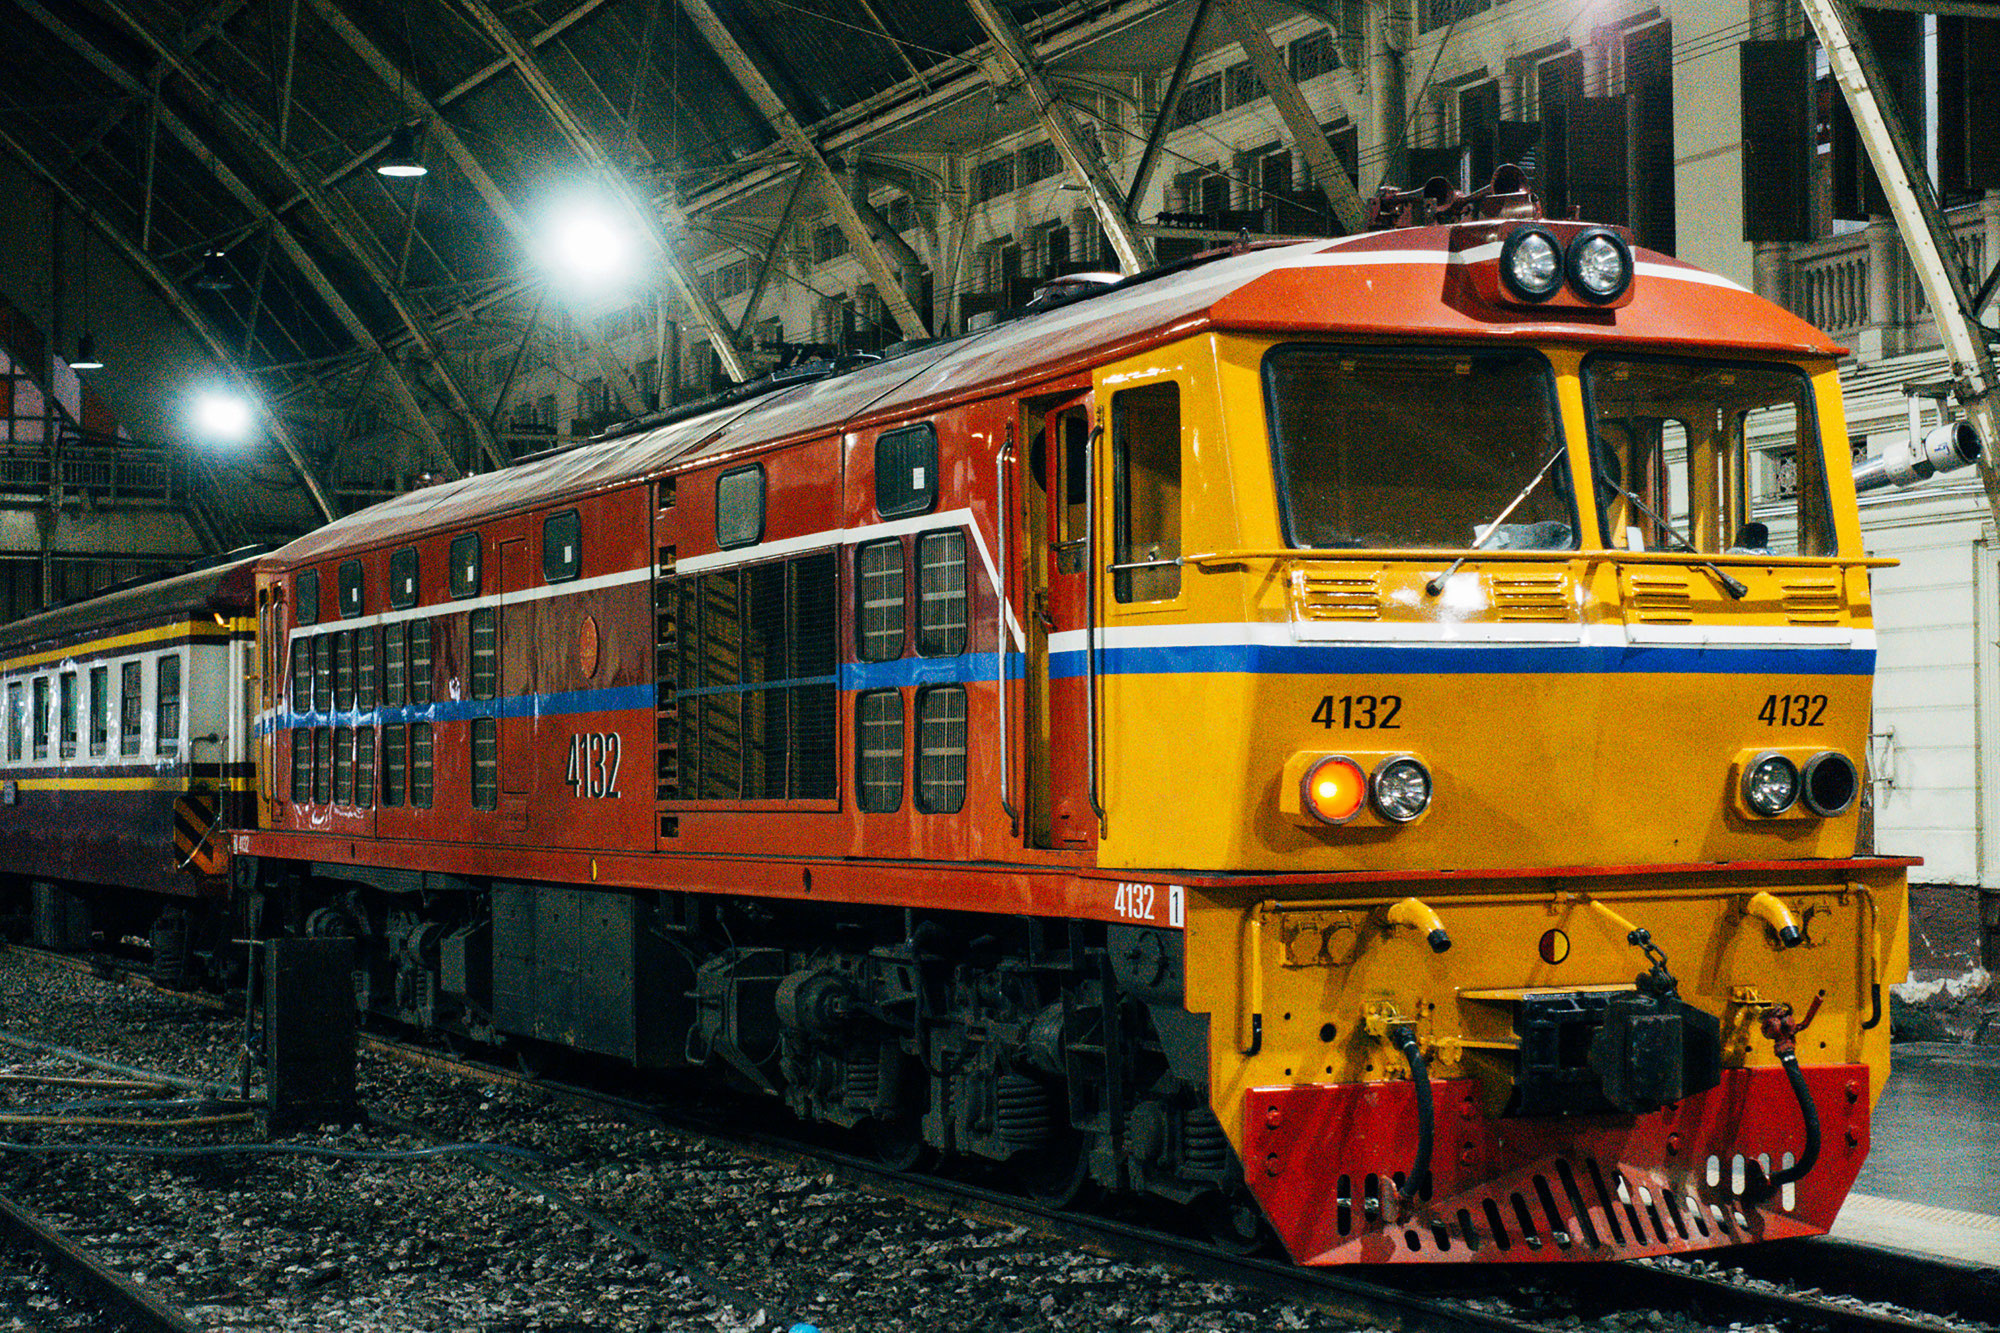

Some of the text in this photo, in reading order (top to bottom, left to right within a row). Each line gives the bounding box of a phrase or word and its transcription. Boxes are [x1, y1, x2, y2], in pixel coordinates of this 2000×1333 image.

[1311, 695, 1401, 729] 4132
[1758, 695, 1828, 726] 4132
[565, 732, 621, 798] 4132
[1114, 883, 1155, 920] 4132
